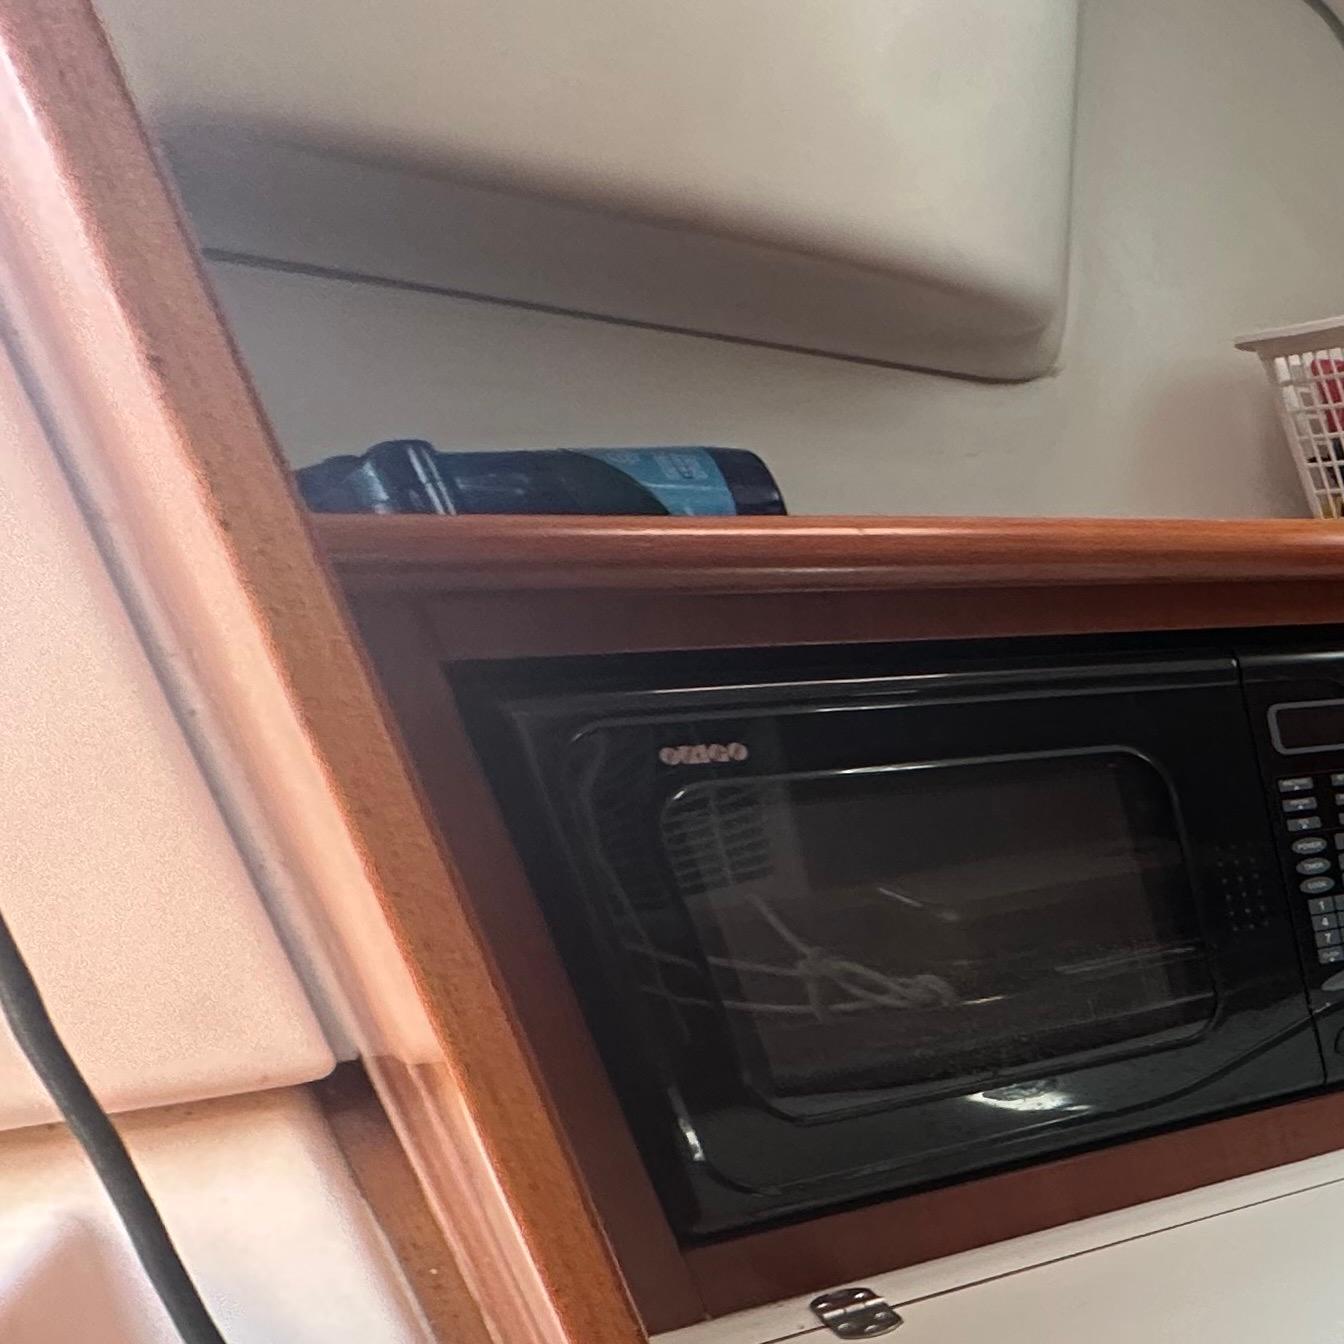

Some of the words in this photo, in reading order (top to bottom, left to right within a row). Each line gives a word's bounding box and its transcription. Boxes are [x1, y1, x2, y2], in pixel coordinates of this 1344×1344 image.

[1318, 900, 1325, 911] 1
[1321, 916, 1329, 926] 4
[1324, 932, 1332, 943] 7
